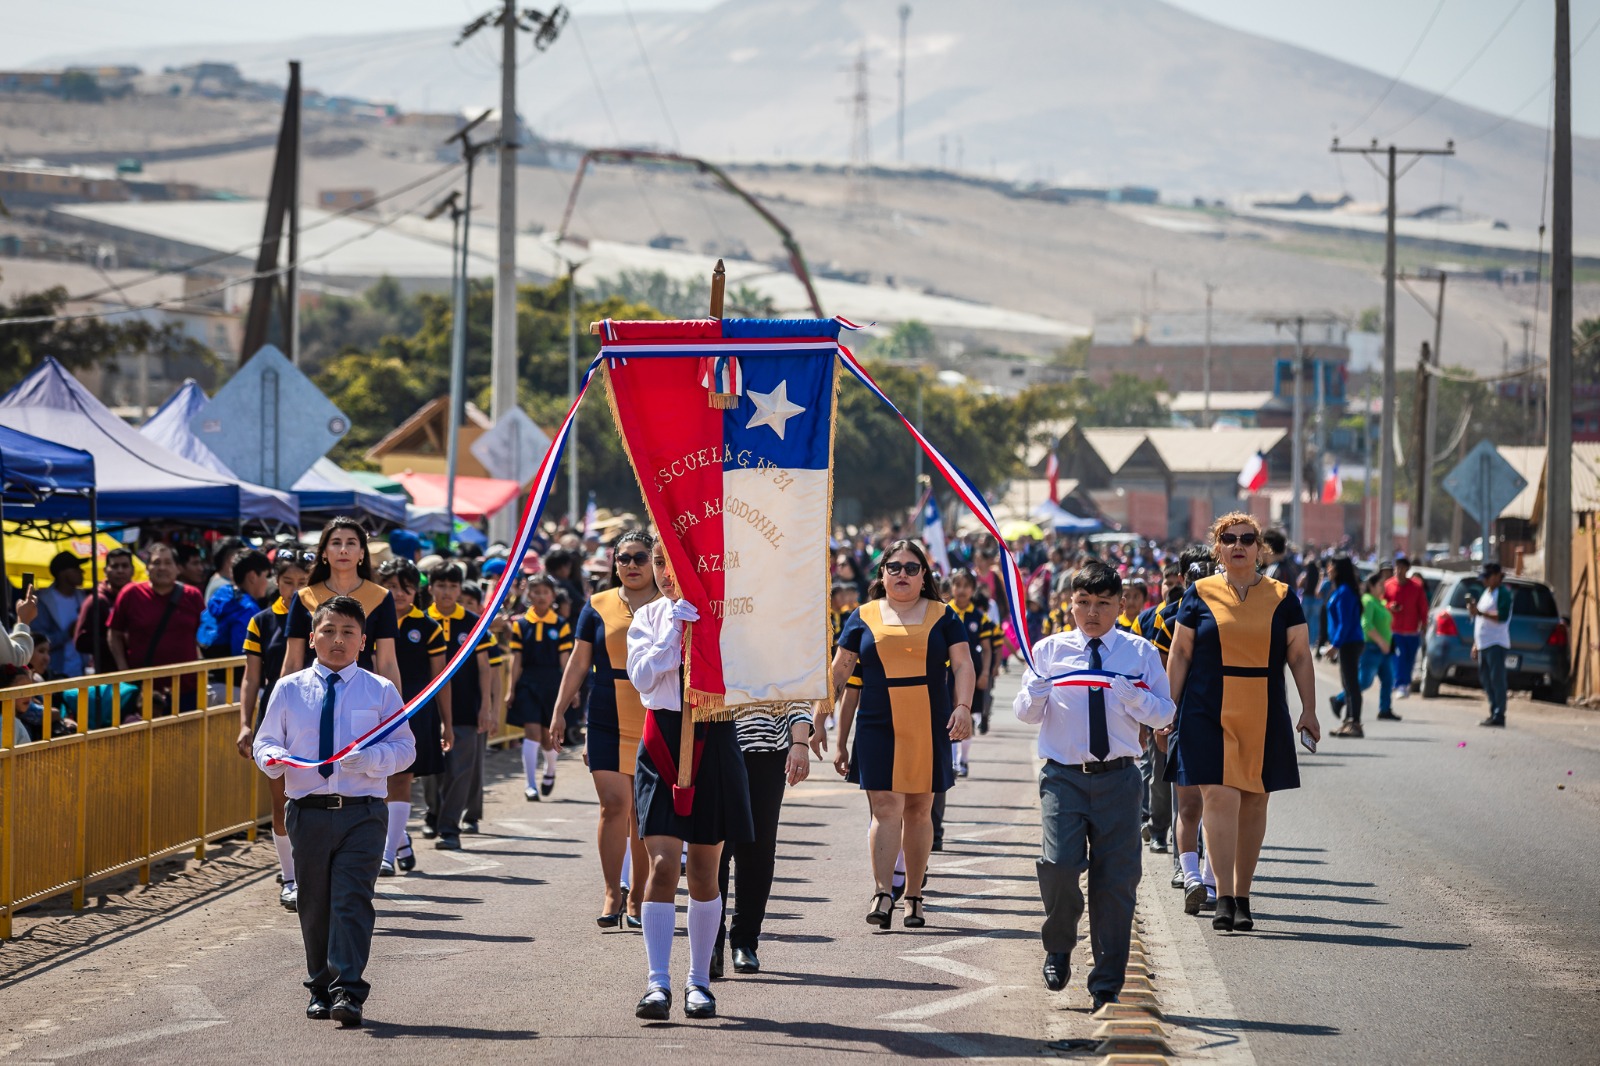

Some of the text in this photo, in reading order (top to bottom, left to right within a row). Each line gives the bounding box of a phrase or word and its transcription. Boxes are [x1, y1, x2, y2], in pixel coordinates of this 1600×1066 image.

[773, 470, 794, 492] 31
[702, 494, 785, 551] ALGODONAL
[696, 550, 741, 573] AZAPA
